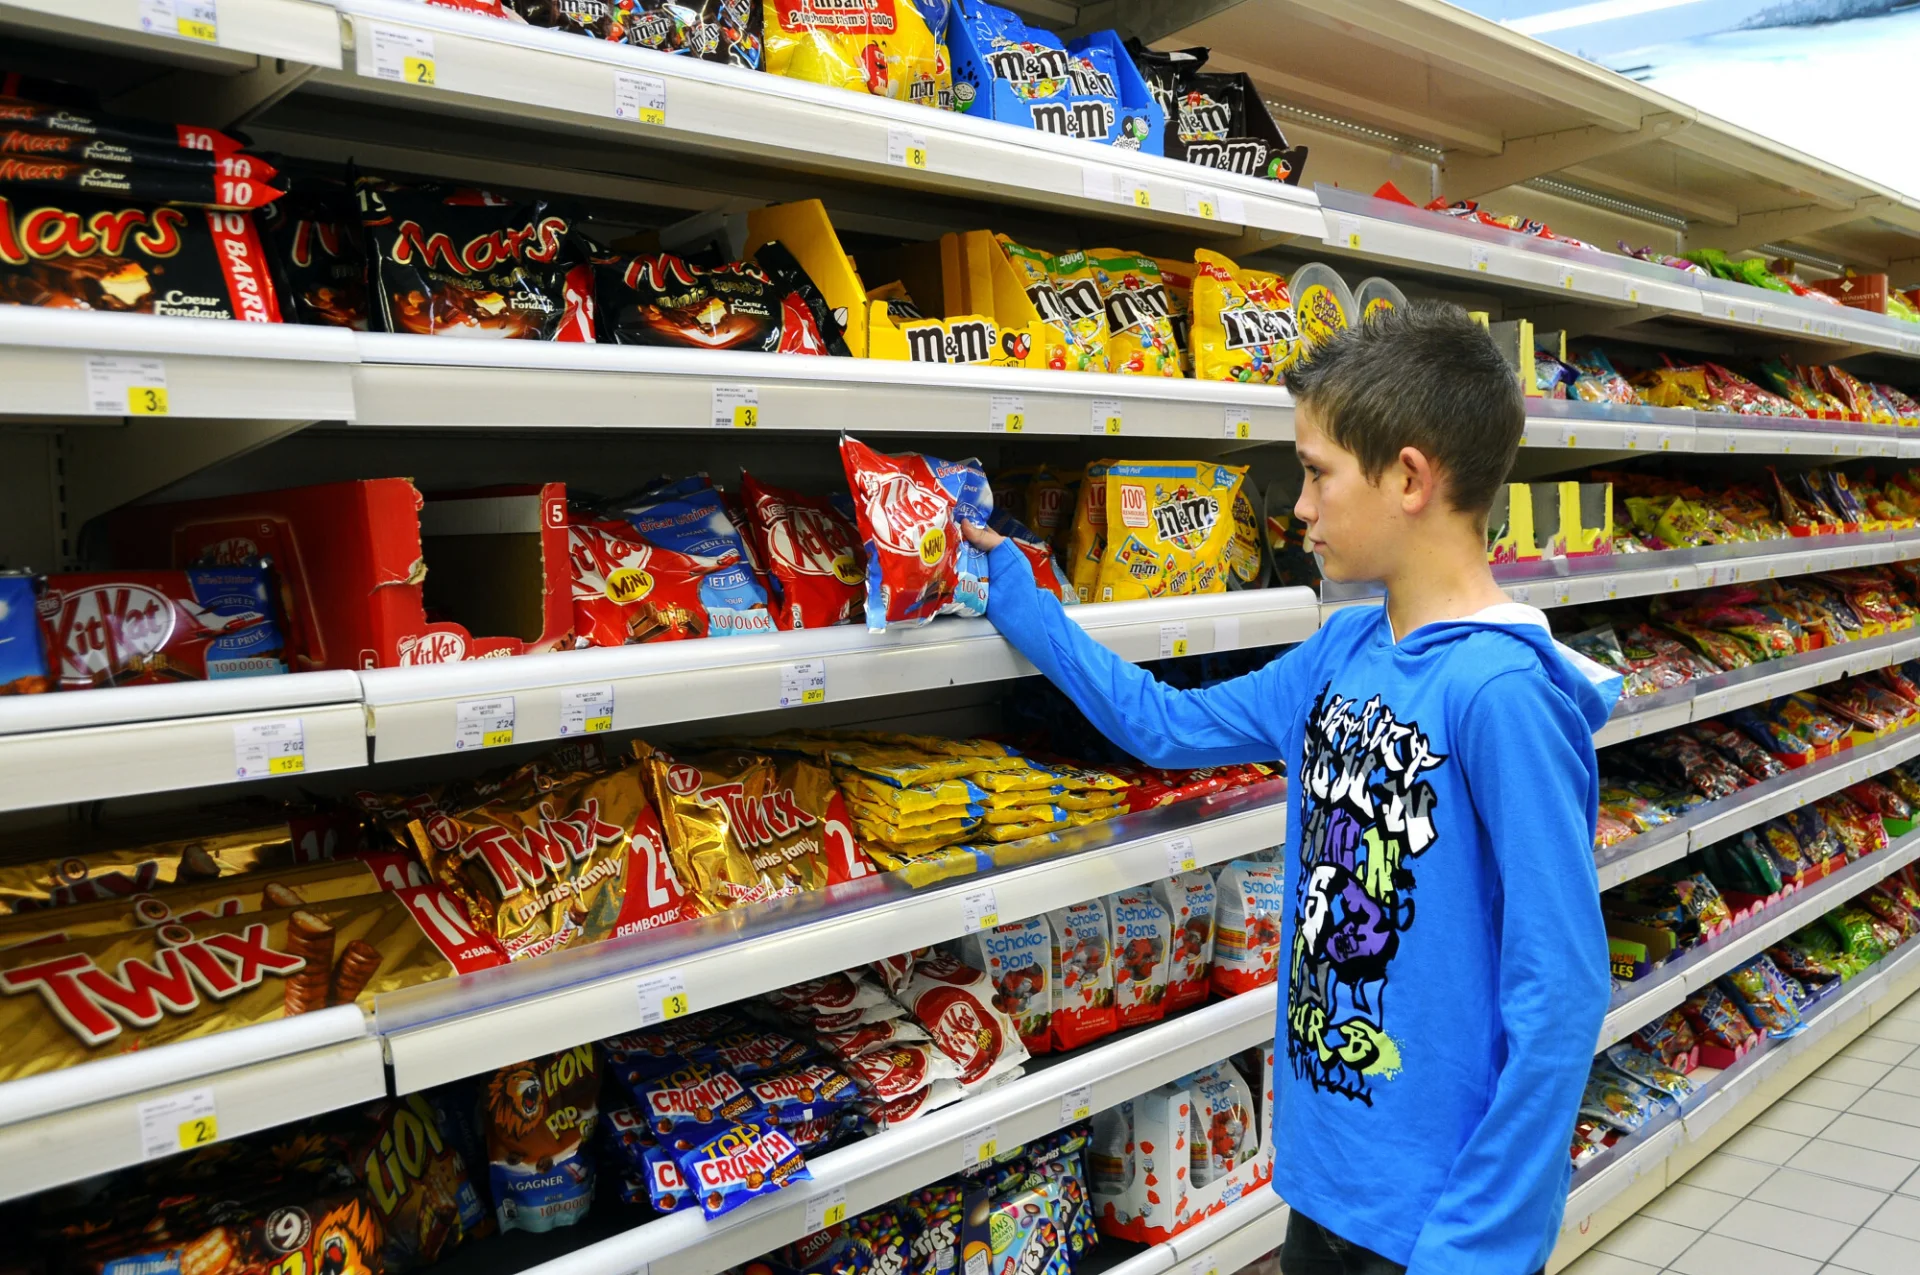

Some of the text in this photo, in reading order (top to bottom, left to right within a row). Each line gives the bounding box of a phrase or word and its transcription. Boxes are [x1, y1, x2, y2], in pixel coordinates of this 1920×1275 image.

[872, 14, 893, 28] 300g
[1033, 102, 1114, 139] m&m's
[185, 132, 213, 151] 10
[223, 158, 251, 178] 10
[222, 182, 252, 205] 10
[209, 211, 245, 235] 10
[392, 217, 568, 276] Mars
[1059, 251, 1084, 267] 500g
[154, 302, 230, 319] Fondant
[730, 304, 770, 316] Fondant
[908, 322, 996, 363] m&m's
[552, 505, 563, 522] 5
[1153, 494, 1219, 539] m&m's
[640, 518, 673, 533] Break
[729, 572, 749, 584] PRI
[42, 588, 161, 675] KitKat
[410, 636, 457, 665] KitKat
[670, 768, 694, 789] 17
[431, 820, 456, 843] 17
[782, 837, 819, 860] family
[518, 857, 624, 922] minis family
[616, 908, 681, 937] REMBOURS
[1066, 911, 1104, 928] Schoko-
[1116, 906, 1164, 923] Schoko-
[1076, 926, 1098, 939] Bons
[1125, 923, 1157, 937] Bons
[472, 945, 492, 957] BAR
[986, 931, 1048, 955] Schoko-
[1000, 951, 1033, 971] Bons
[652, 1073, 741, 1113] CRUNCH
[546, 1106, 578, 1140] POP
[701, 1123, 760, 1160] TOP
[701, 1133, 791, 1186] CRUNCH
[516, 1175, 563, 1191] GAGNER
[275, 1213, 300, 1248] 9
[801, 1230, 832, 1257] 240g
[967, 1254, 984, 1267] OHNE
